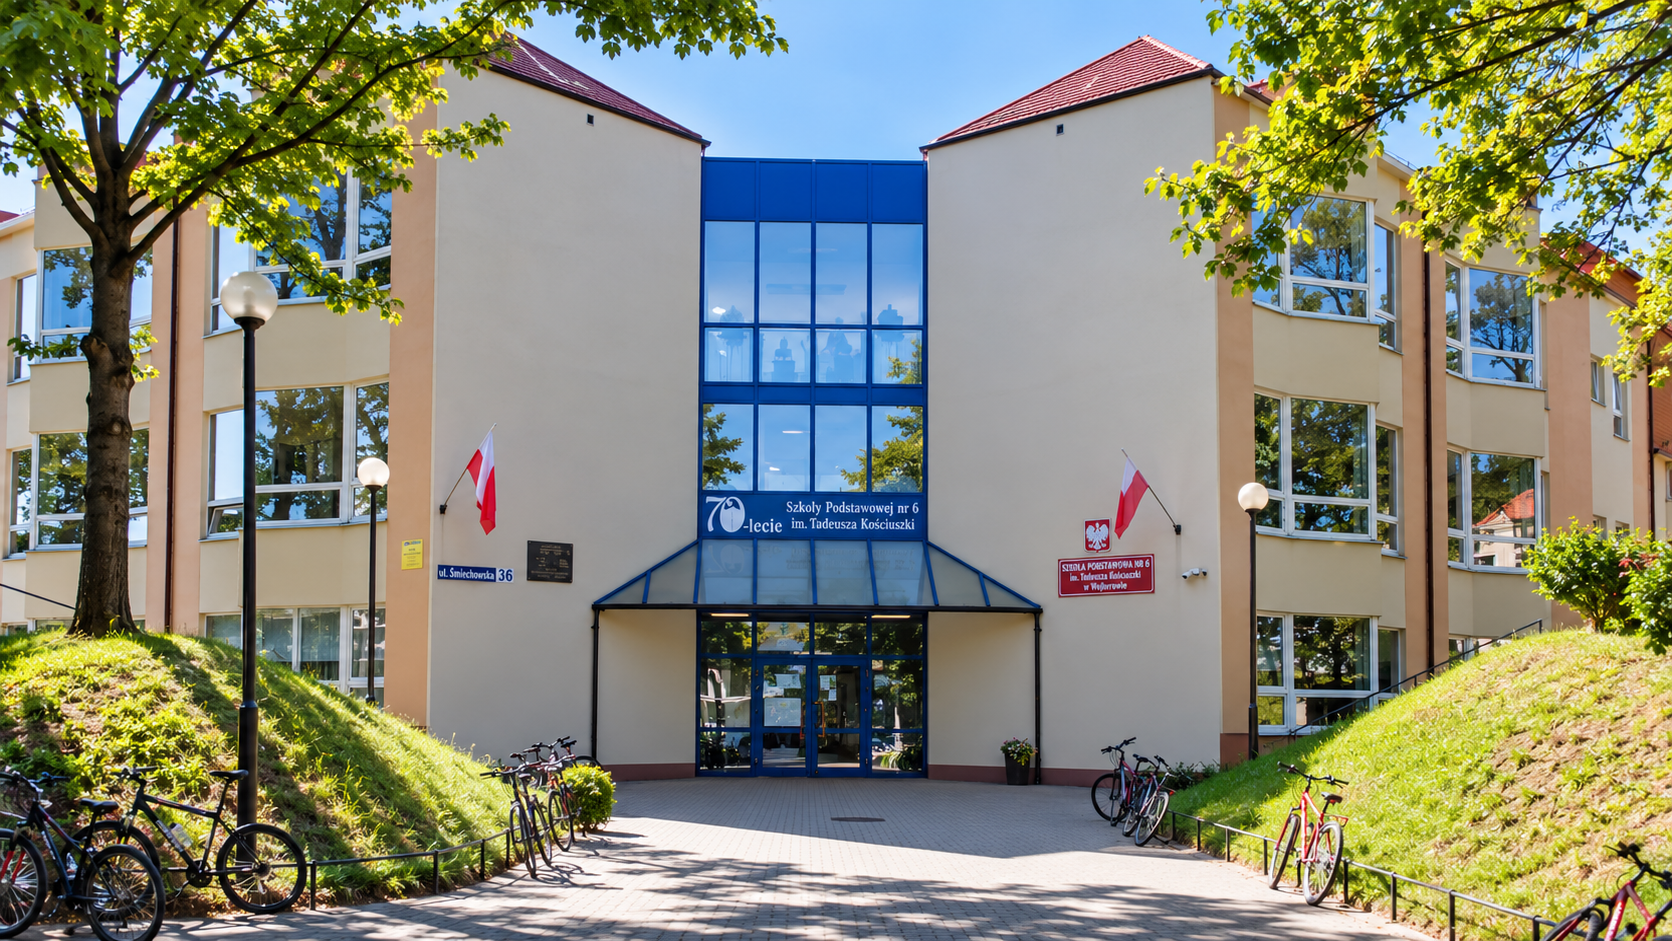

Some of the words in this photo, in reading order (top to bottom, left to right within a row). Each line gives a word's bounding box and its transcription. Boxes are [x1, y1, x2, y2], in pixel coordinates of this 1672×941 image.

[825, 501, 894, 517] Podstawowej
[897, 504, 910, 514] nr
[912, 502, 919, 514] 6
[791, 517, 808, 529] im.
[809, 517, 857, 530] Tadeusza
[861, 517, 915, 530] Kościuszki
[1145, 559, 1150, 568] 6
[438, 567, 448, 578] ul.
[498, 568, 513, 582] 36
